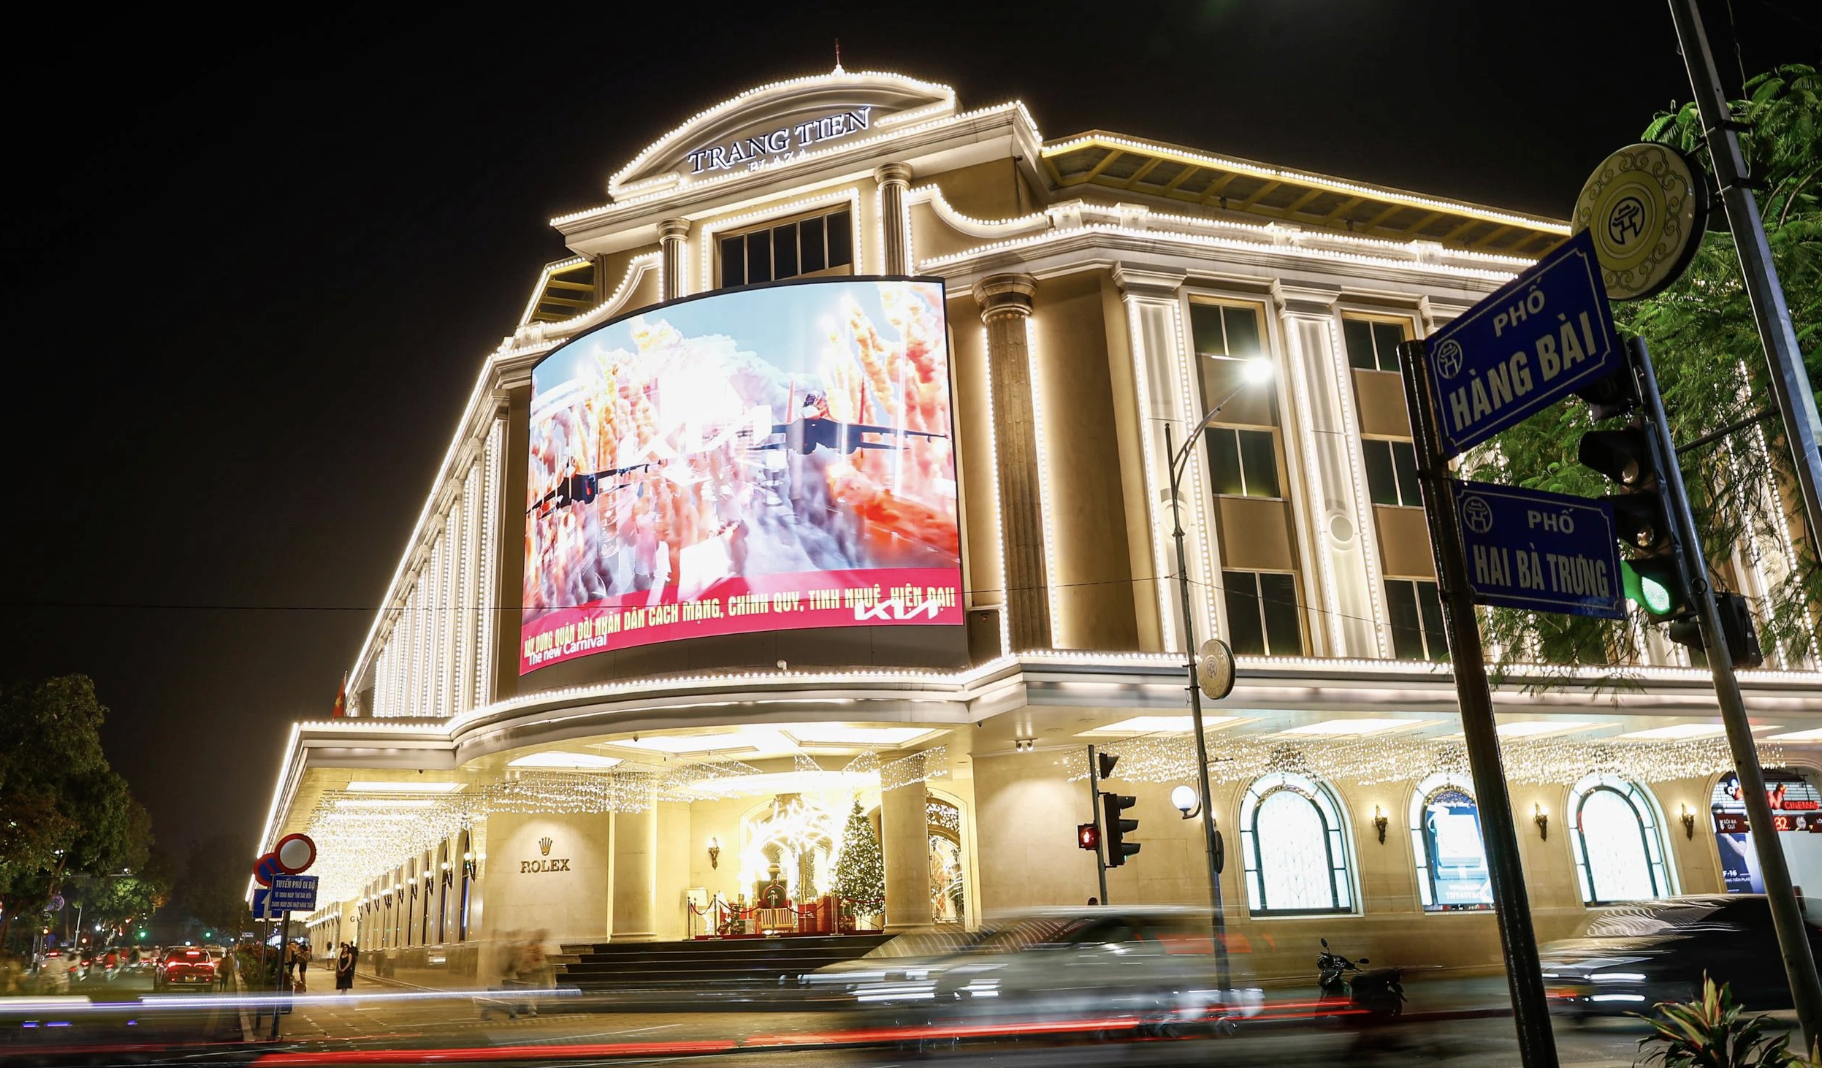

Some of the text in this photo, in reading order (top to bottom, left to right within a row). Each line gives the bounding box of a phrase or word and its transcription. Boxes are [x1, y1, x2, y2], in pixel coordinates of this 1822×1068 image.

[687, 106, 872, 175] TRANG TIEN
[1493, 276, 1545, 337] PHỐ
[1449, 311, 1597, 432] HÀNG BÀI
[1527, 508, 1575, 534] PHỐ
[1473, 543, 1610, 598] HAI BÀ TRƯNG
[595, 611, 621, 636] NHÂN
[624, 607, 645, 631] DÂN
[648, 602, 679, 627] CÁCH
[682, 598, 724, 624] MẠNG,
[728, 591, 769, 616] CHÍNH
[773, 591, 804, 613] QUY,
[808, 589, 840, 610] TINH
[854, 598, 939, 621] KIA
[529, 632, 608, 666] The new Carnival
[1784, 801, 1820, 810] CINEMAS
[520, 859, 571, 873] ROLEX
